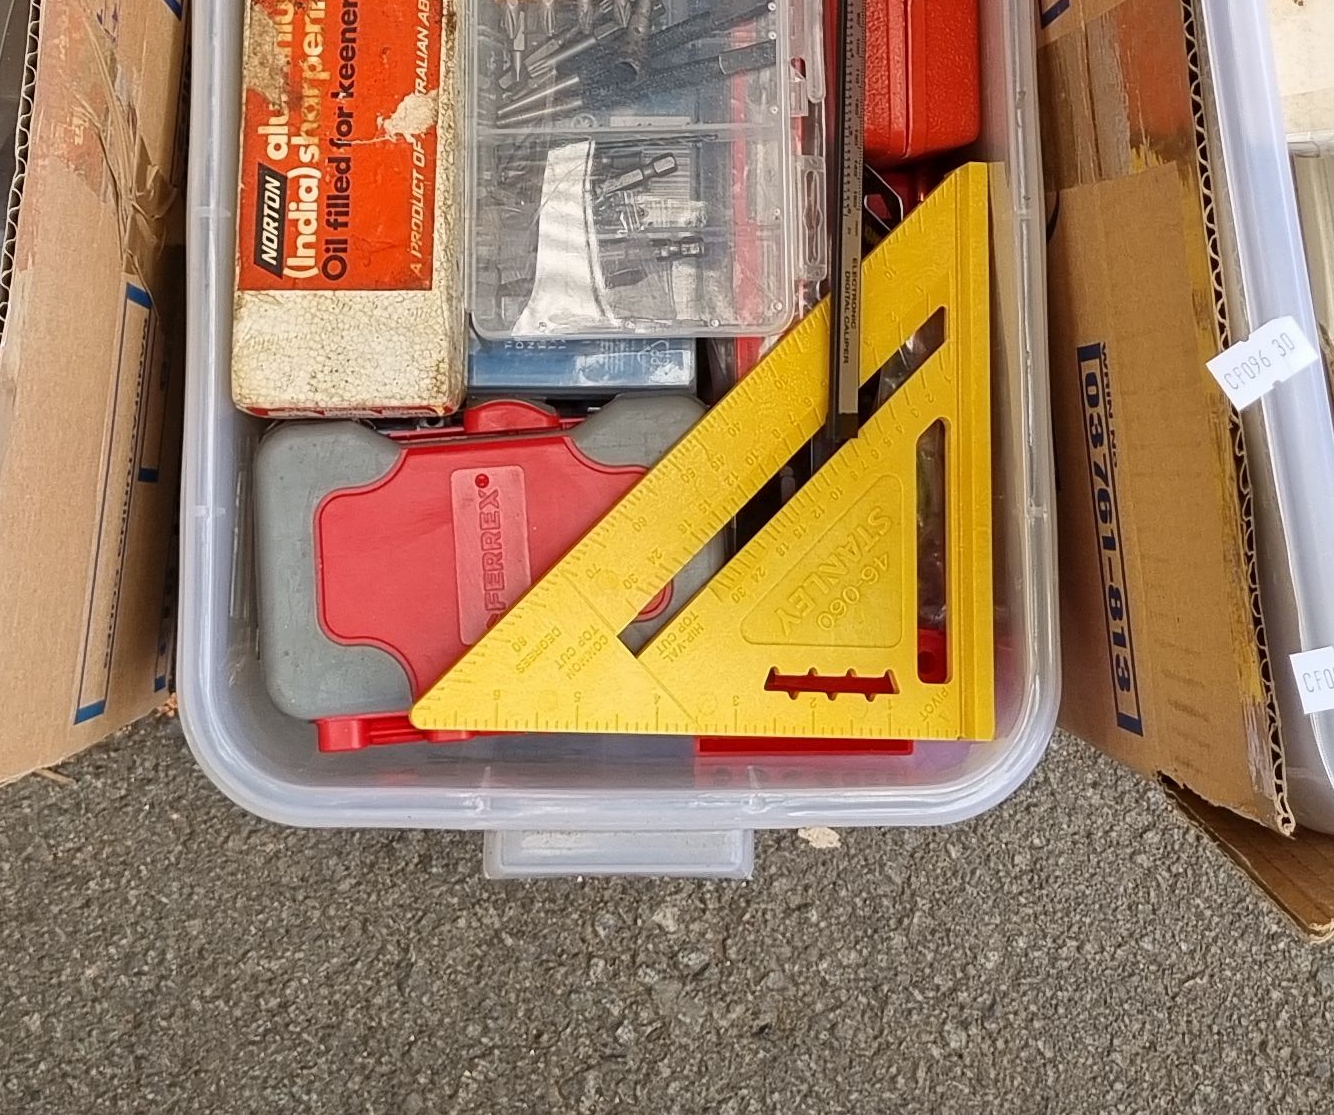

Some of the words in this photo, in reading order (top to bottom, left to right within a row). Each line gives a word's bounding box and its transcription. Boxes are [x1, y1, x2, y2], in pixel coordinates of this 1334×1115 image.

[330, 106, 354, 149] for
[412, 139, 426, 169] OF
[325, 157, 352, 230] filled
[408, 173, 425, 259] PRODUCT
[261, 176, 281, 265] NORTON
[283, 167, 322, 278] (India)
[321, 239, 348, 281] Oil
[410, 262, 423, 277] A
[843, 316, 851, 364] CALIPER
[1223, 350, 1271, 390] CF096
[1271, 332, 1296, 357] 30
[478, 489, 507, 612] FERREX
[1083, 372, 1131, 694] 03761-813
[622, 573, 639, 590] 30
[731, 587, 748, 604] 30
[774, 507, 892, 636] STANLEY
[816, 551, 889, 631] 46-060
[515, 626, 563, 674] DEGREES
[920, 687, 950, 722] PIVOT
